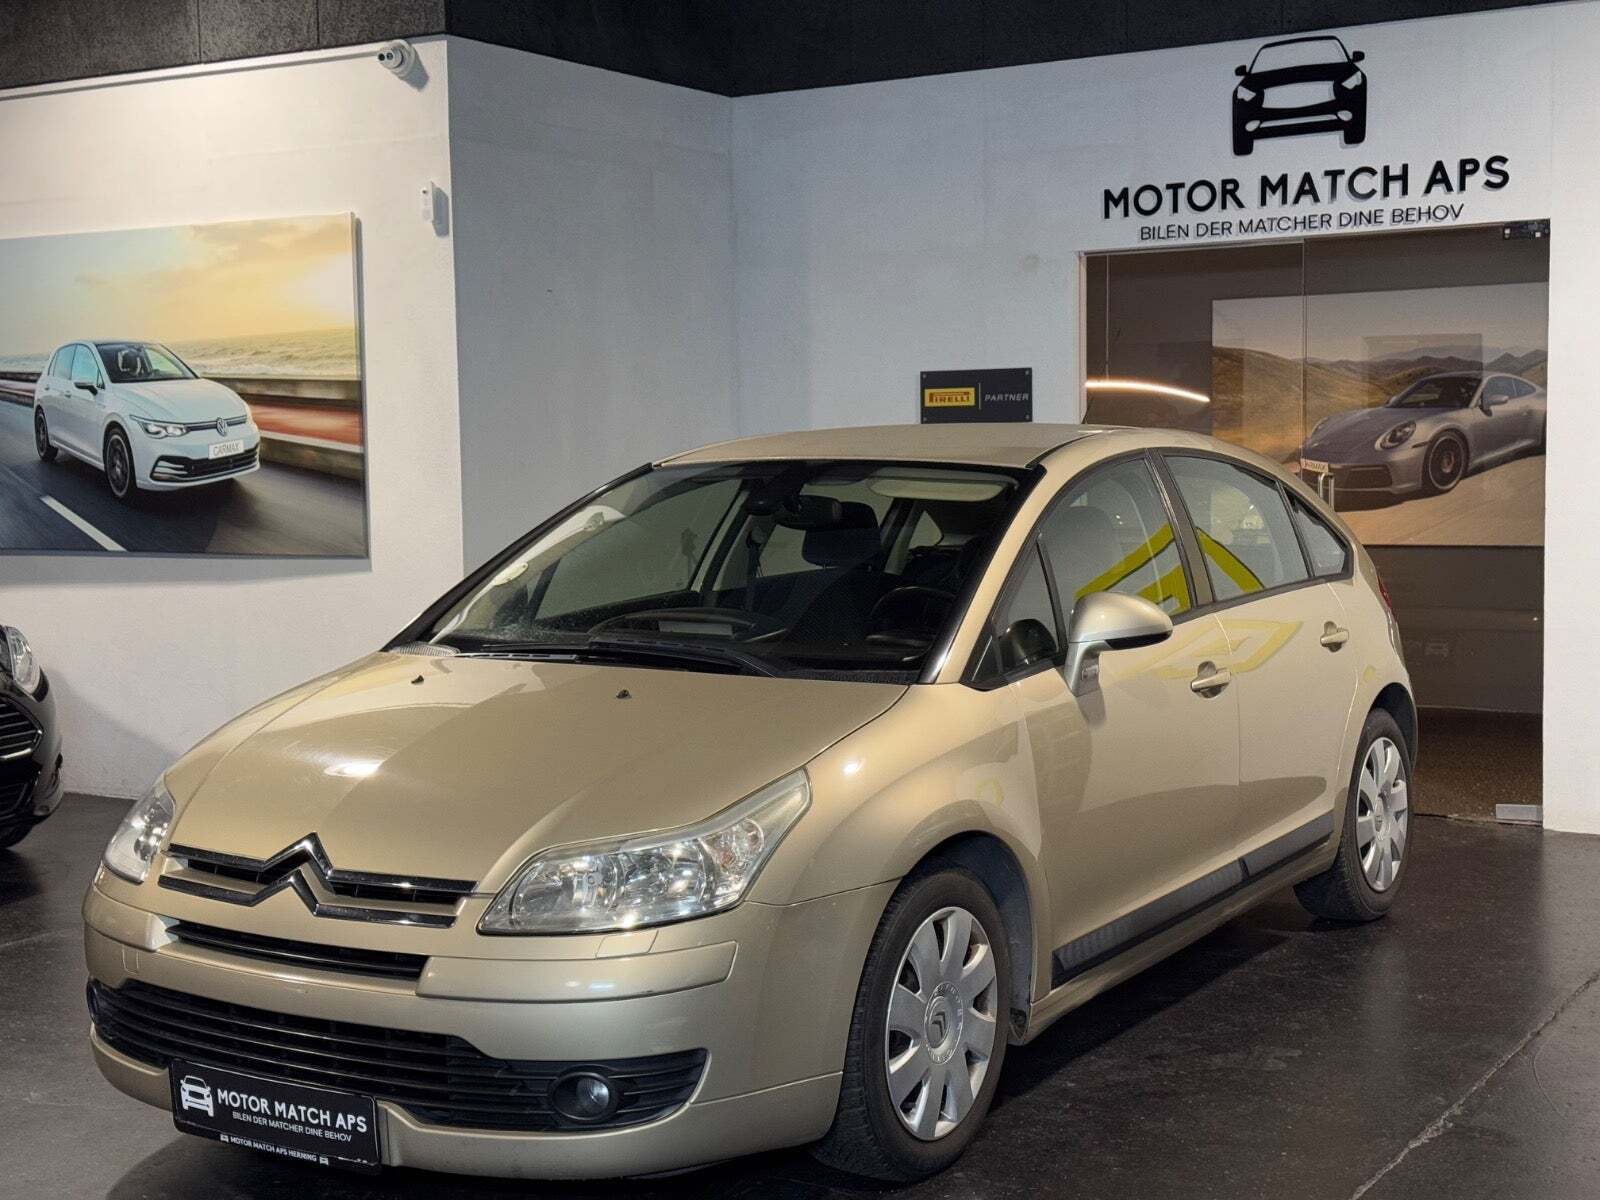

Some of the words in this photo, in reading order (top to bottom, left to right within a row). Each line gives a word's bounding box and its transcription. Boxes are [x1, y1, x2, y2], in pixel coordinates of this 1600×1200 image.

[1103, 178, 1245, 219] MOTOR
[1261, 163, 1408, 207] MATCH
[1424, 155, 1510, 195] APS
[1140, 223, 1189, 242] BILEN
[1196, 221, 1233, 238] DER
[1238, 213, 1331, 235] MATCHER
[1339, 209, 1384, 229] DINE
[1392, 204, 1465, 224] BEHOV
[929, 391, 970, 403] PIRELLI
[984, 392, 1030, 402] PARTNER
[216, 1088, 271, 1116] MOTOR
[275, 1100, 331, 1127] MATCH
[335, 1112, 368, 1133] APS
[232, 1110, 252, 1122] BILEN
[252, 1115, 268, 1126] DER
[268, 1118, 304, 1134] MATCHER
[305, 1126, 323, 1137] DINE
[324, 1130, 352, 1142] BEHOV
[230, 1136, 252, 1147] MOTOR
[252, 1141, 275, 1152] MATCH
[275, 1146, 288, 1156] APS
[288, 1149, 317, 1162] HERNING
